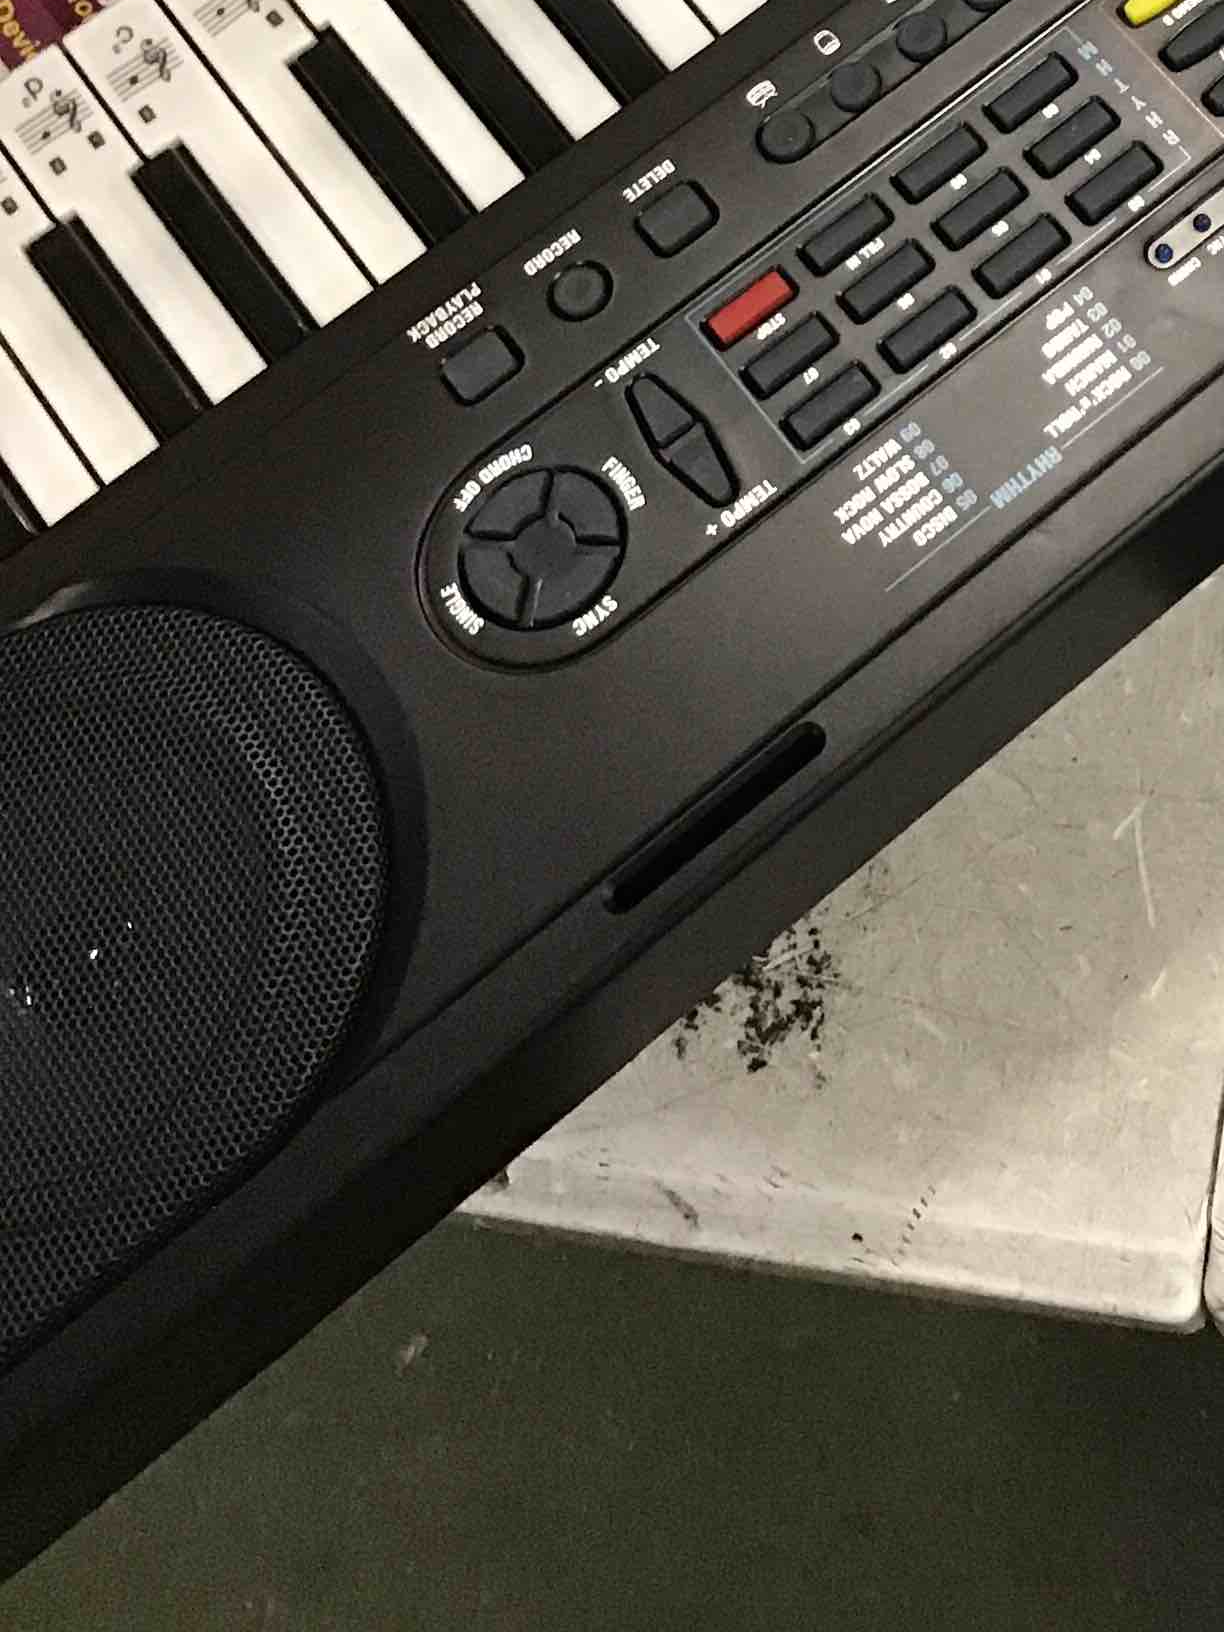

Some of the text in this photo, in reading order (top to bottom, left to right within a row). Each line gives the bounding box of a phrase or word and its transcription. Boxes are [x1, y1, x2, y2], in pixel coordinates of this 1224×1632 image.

[622, 159, 676, 203] DELETE
[523, 228, 582, 276] RECORD
[406, 281, 482, 343] PLAYBACK
[1071, 286, 1094, 307] 04
[1086, 301, 1109, 323] 03
[424, 300, 484, 349] RECORD
[756, 312, 787, 341] STOP
[1100, 317, 1122, 339] 02
[604, 337, 661, 383] TEMPO
[453, 444, 533, 513] CHORD OFF
[852, 438, 903, 481] WALTZ
[873, 454, 916, 494] SLOW
[989, 445, 1063, 509] RHYTHM
[601, 456, 646, 511] FINGER
[720, 479, 778, 528] TEMPO
[833, 485, 877, 525] ROCK
[840, 455, 950, 545] 07 BOSSA NOVA
[877, 488, 943, 548] COUNTRY
[912, 505, 958, 547] DISCO
[440, 582, 485, 636] SINGLE
[572, 595, 618, 637] SYNC
